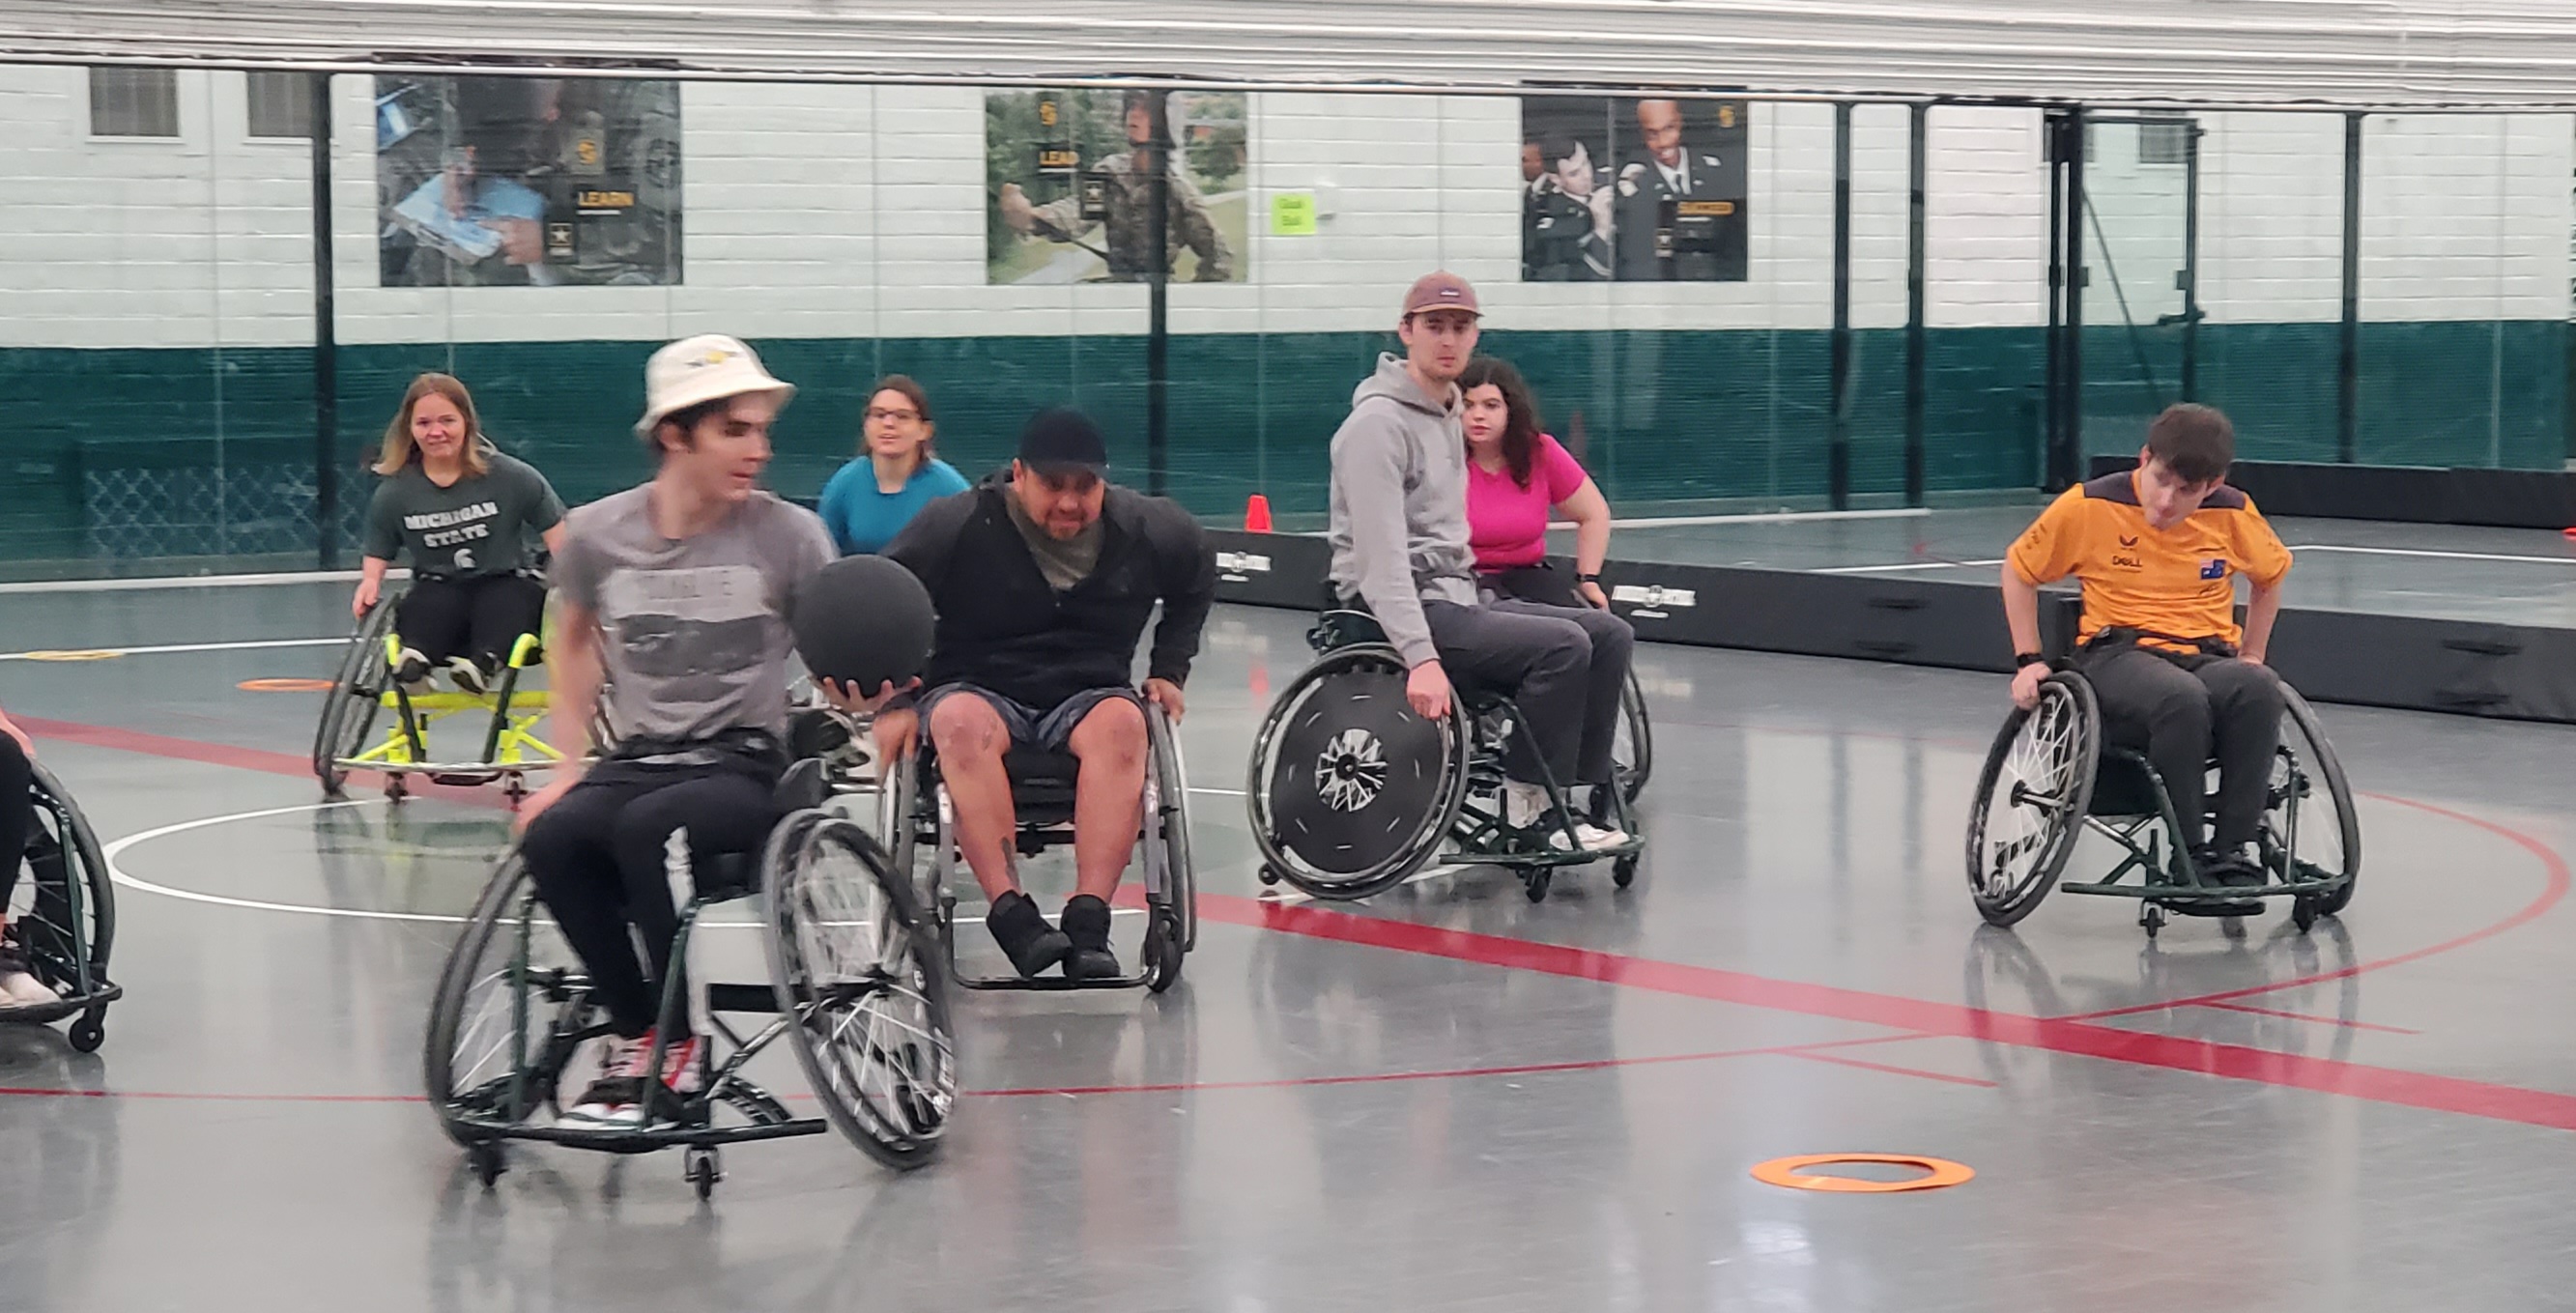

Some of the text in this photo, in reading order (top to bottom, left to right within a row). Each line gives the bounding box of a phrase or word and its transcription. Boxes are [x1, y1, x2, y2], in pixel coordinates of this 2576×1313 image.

[578, 191, 634, 207] LEARN
[403, 500, 500, 530] MICHIGAN
[423, 523, 490, 548] STATE
